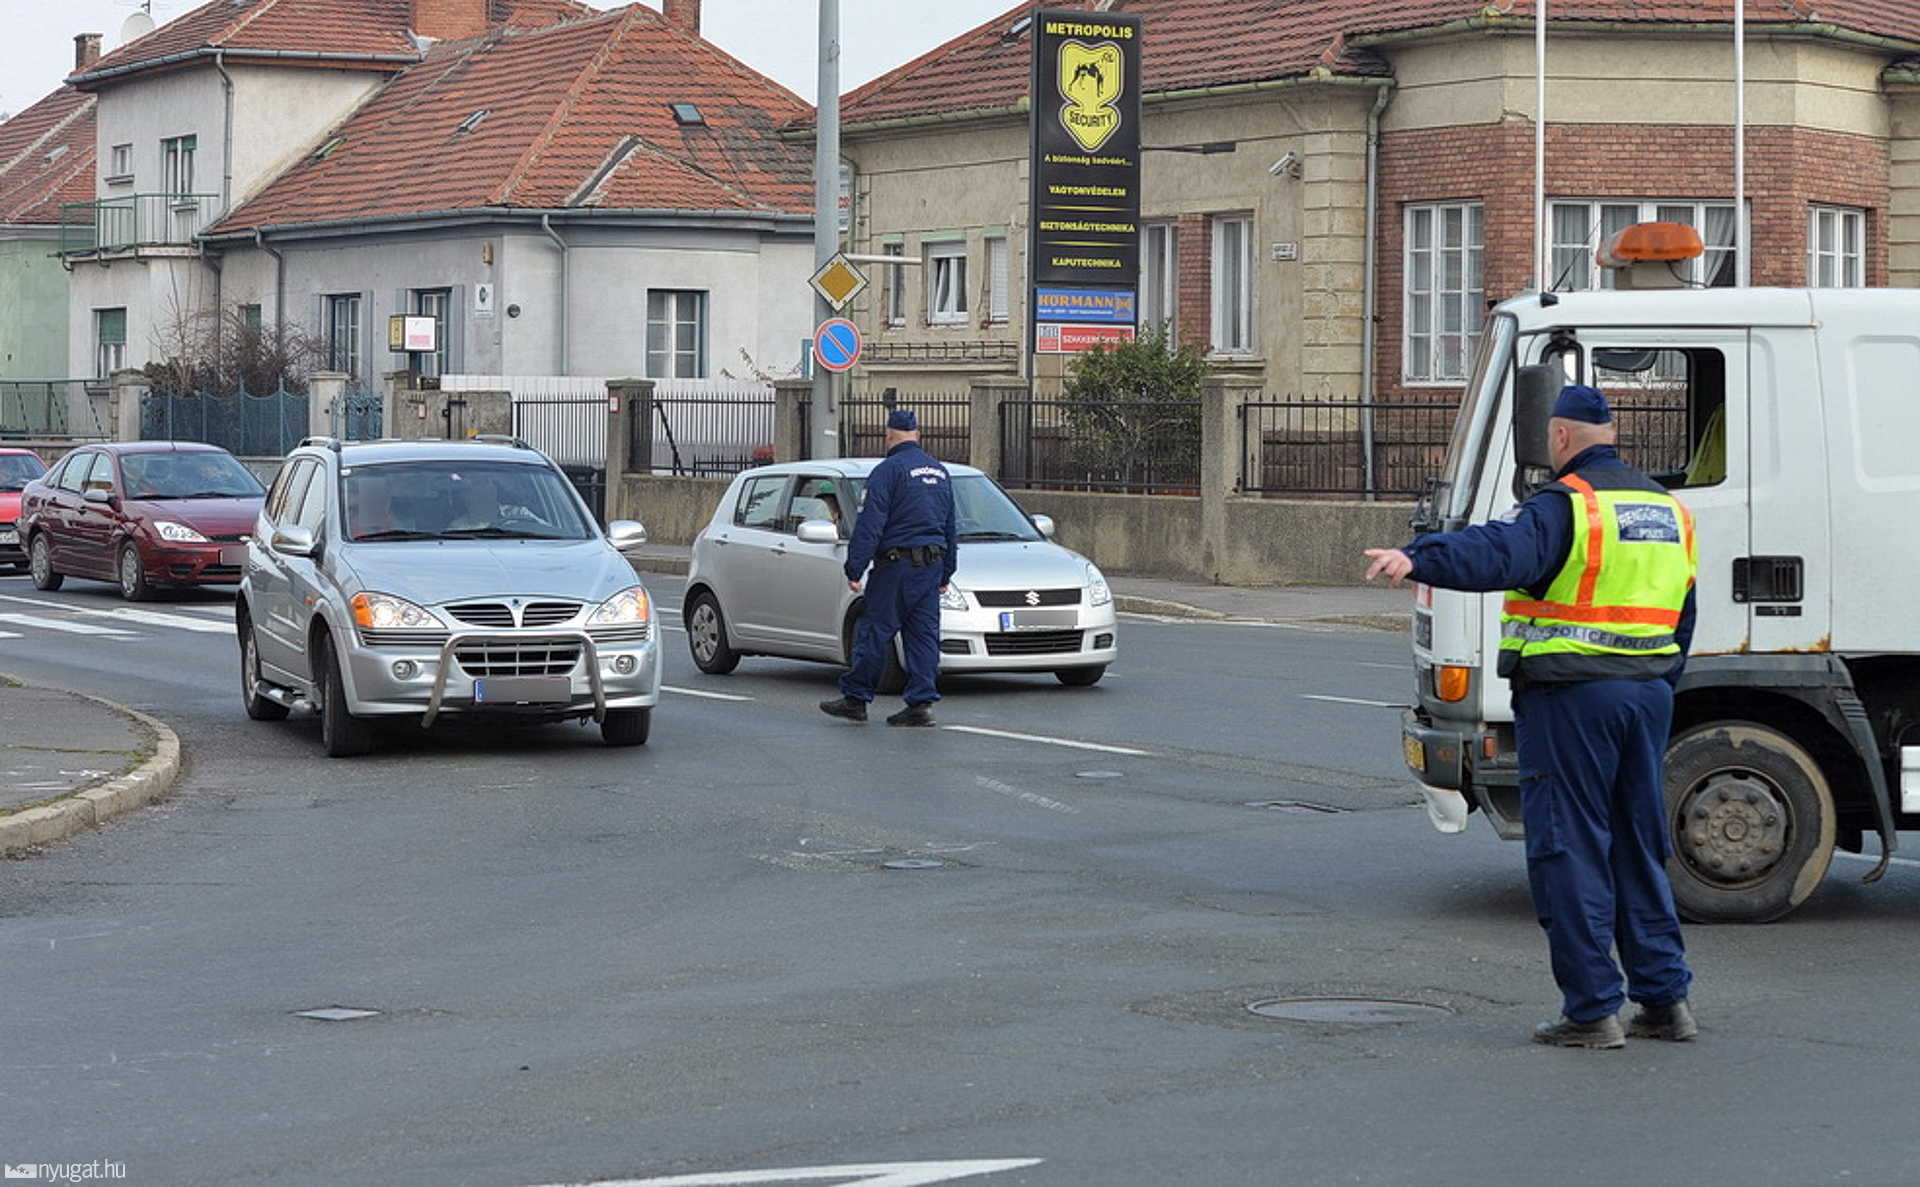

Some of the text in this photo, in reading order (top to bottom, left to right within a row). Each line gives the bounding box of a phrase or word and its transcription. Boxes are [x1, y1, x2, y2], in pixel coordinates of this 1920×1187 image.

[1046, 22, 1133, 39] METROPOLIS
[1069, 109, 1113, 128] SECURITY
[1044, 154, 1051, 162] A
[1049, 185, 1126, 196] VAGYONVÉDELEM
[1040, 221, 1135, 233] BIZTONSÁGTECHNIKA
[1052, 256, 1122, 268] KAPUTECHNIKA
